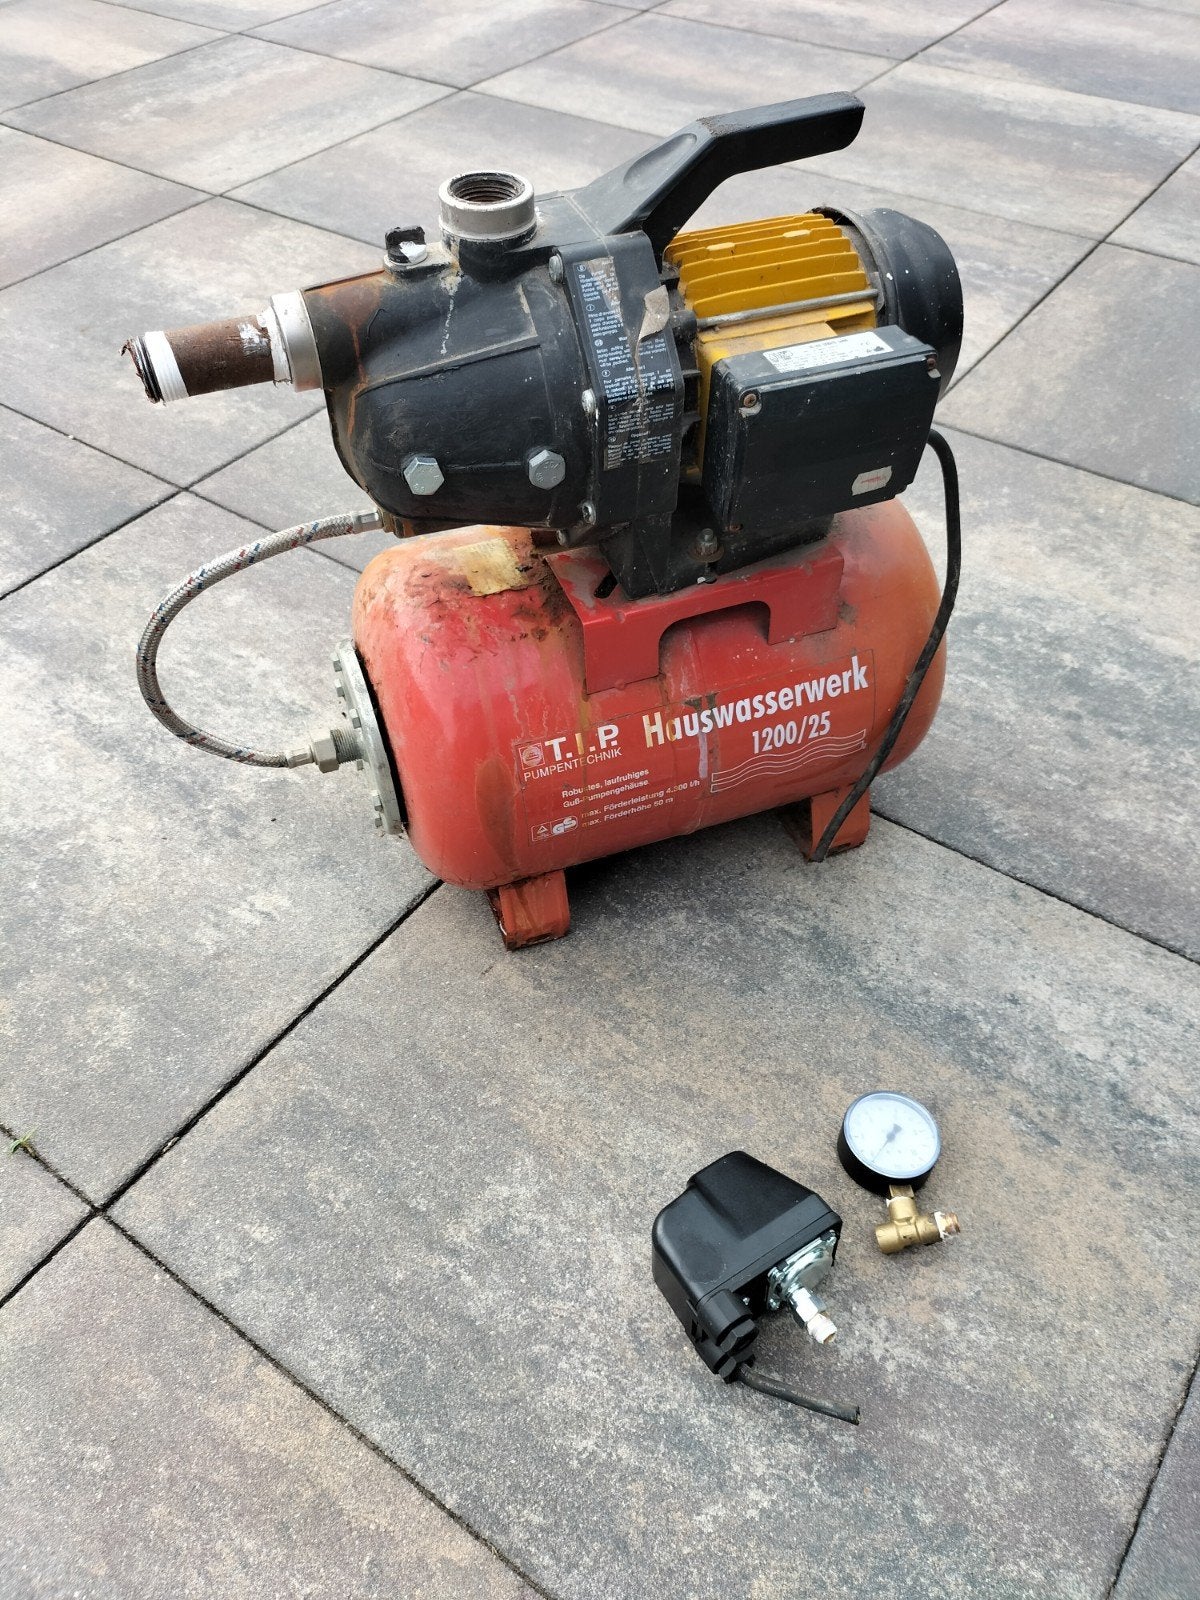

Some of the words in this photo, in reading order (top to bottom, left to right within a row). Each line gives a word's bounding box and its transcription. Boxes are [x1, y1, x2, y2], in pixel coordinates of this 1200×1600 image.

[642, 656, 869, 748] Hauswasserwerk
[544, 724, 619, 761] T.I.P.
[752, 711, 831, 754] 1200/25
[523, 747, 623, 782] PUMPENTECHNIK
[604, 768, 650, 787] laufruhiges
[562, 779, 650, 809] Guß-Pumpengehäuse
[581, 808, 602, 819] max.
[603, 789, 665, 813] Förderleistung
[581, 818, 602, 829] max.
[604, 803, 652, 822] Förderhöhe
[653, 799, 664, 808] 50
